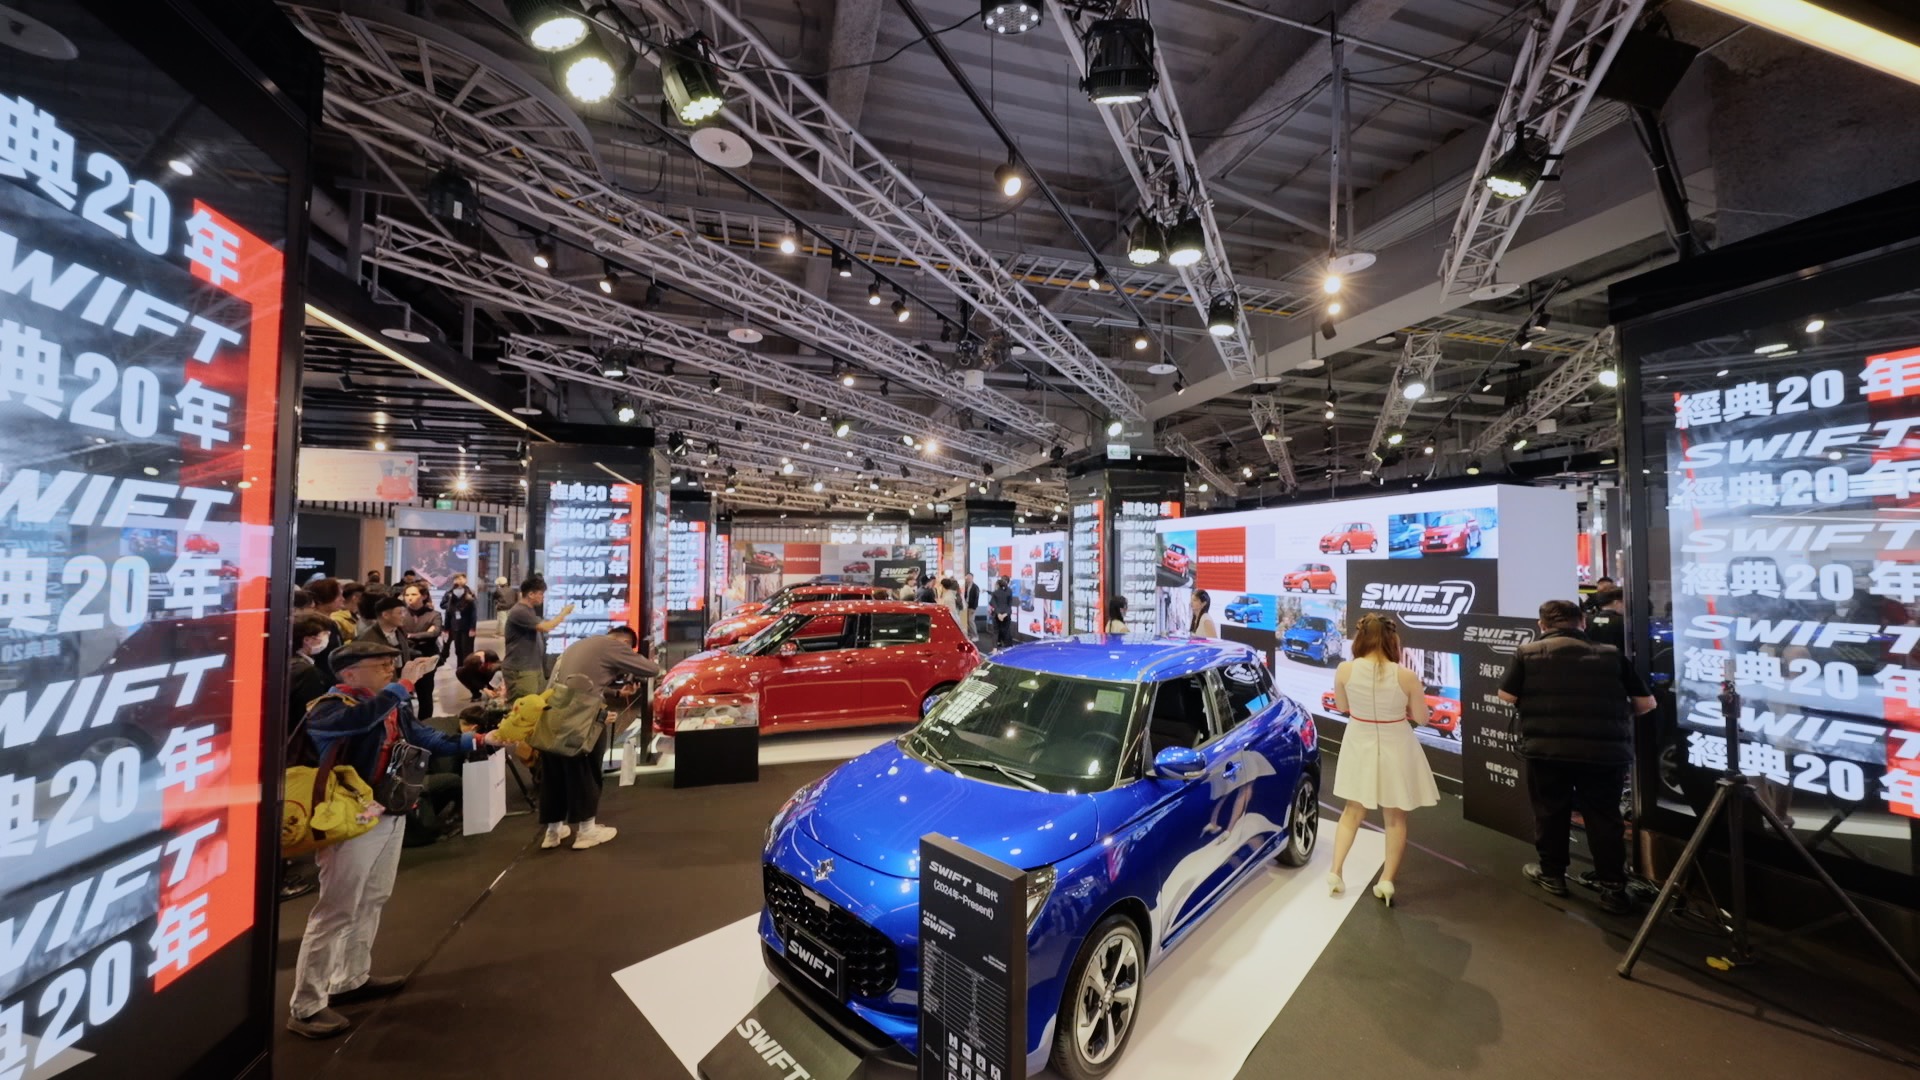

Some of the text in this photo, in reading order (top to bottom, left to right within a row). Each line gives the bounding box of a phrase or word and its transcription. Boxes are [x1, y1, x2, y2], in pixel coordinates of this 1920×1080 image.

[1678, 417, 1920, 469] SWIFT
[551, 507, 629, 520] SWIFT
[831, 532, 857, 545] POP
[862, 532, 897, 545] MART
[1681, 523, 1920, 552] SWIFT
[549, 545, 628, 557] SWIFT
[549, 583, 628, 596] SWIFT
[1362, 583, 1465, 604] SWIFT
[1464, 626, 1528, 641] SWIFT
[1684, 615, 1920, 655] SWIFT
[929, 861, 972, 887] SWIFT
[922, 916, 956, 940] SWIFT
[788, 939, 835, 979] SWIFT
[736, 1018, 811, 1080] SWIFT
